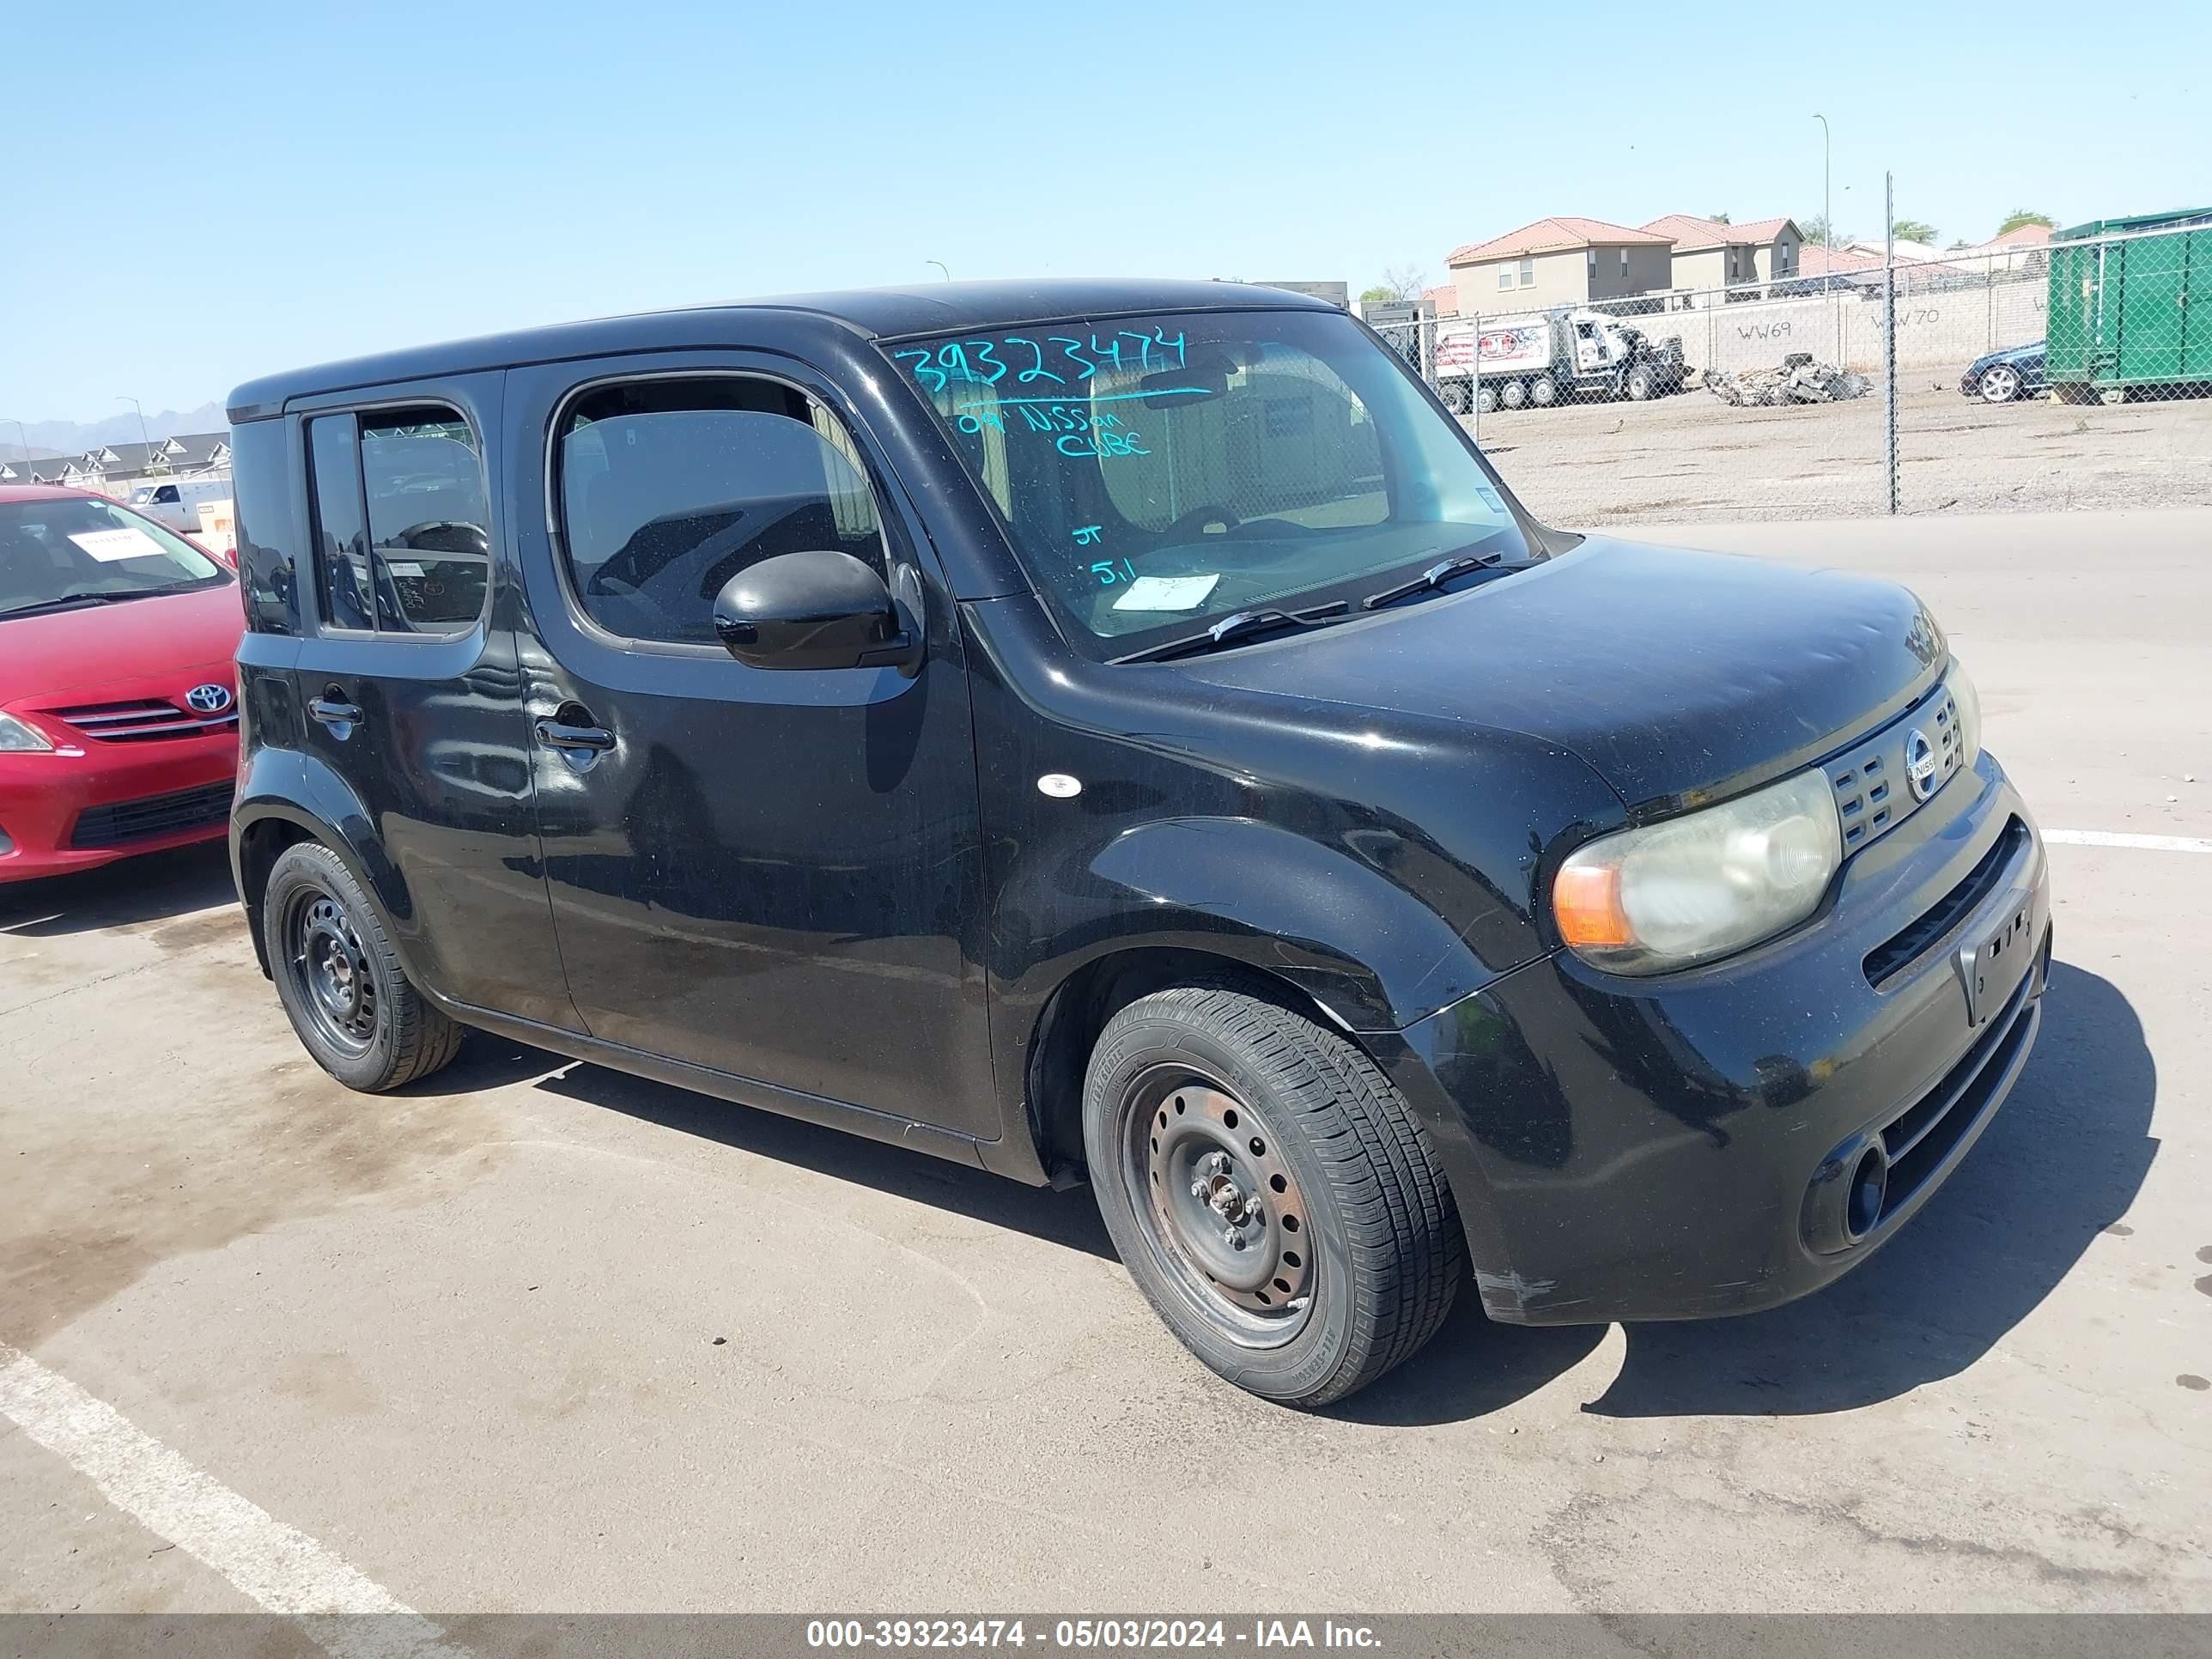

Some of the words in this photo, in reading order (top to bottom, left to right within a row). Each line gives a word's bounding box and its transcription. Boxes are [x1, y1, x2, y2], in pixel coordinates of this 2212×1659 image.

[1737, 322, 1791, 340] WW69
[895, 325, 1186, 392] 39323474
[1056, 432, 1152, 457] CUBE
